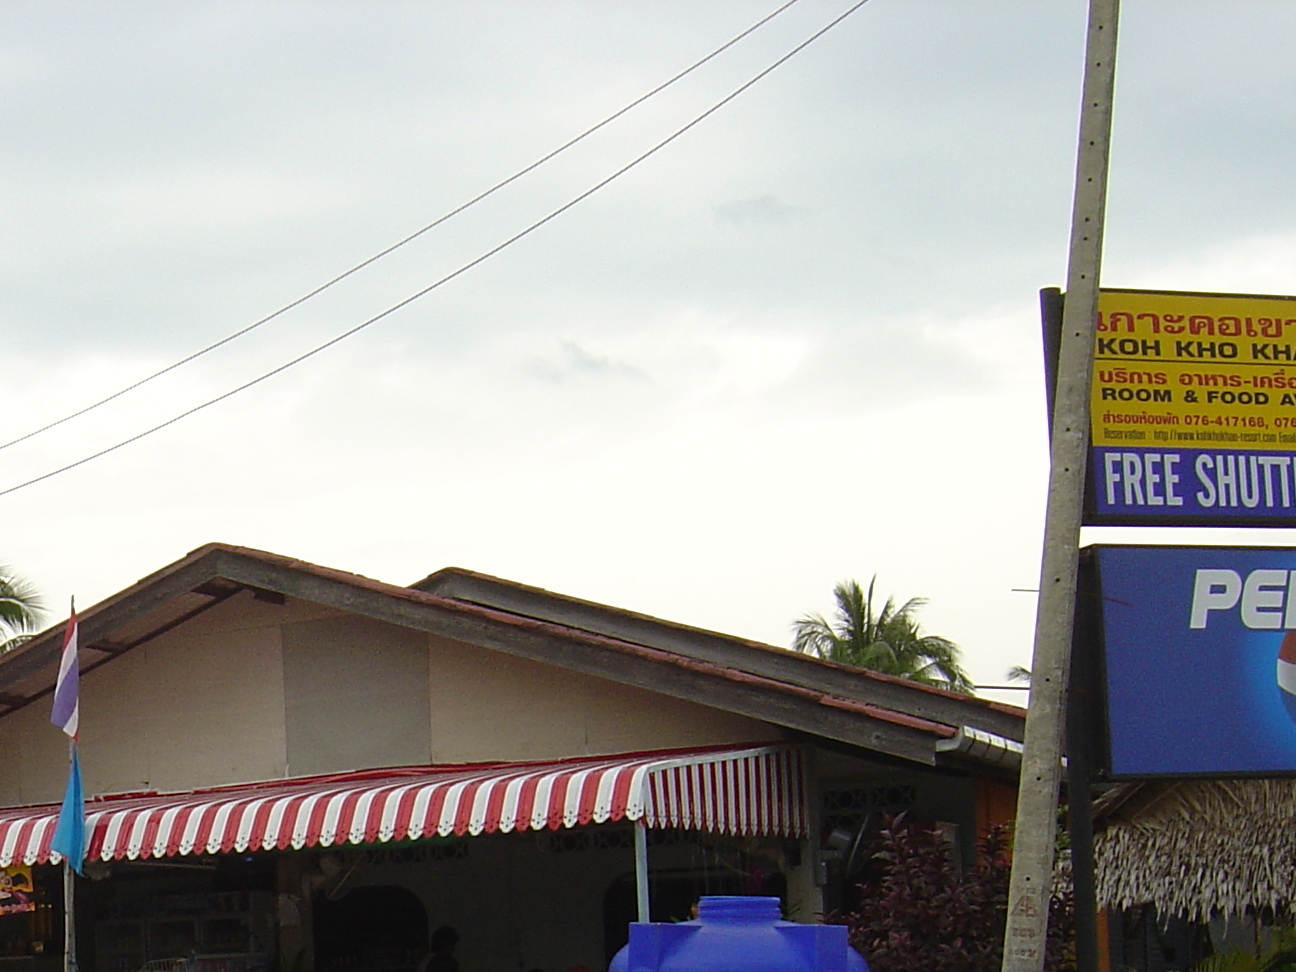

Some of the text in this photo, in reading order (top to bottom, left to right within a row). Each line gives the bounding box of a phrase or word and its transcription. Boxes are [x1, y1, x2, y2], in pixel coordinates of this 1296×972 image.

[1098, 338, 1296, 361] KOH KHO KH
[1098, 367, 1168, 385] บริการ
[1101, 387, 1296, 406] ROOM & FOOD A
[1184, 414, 1269, 429] 076-417168,
[1104, 452, 1296, 508] FREE SHUTT
